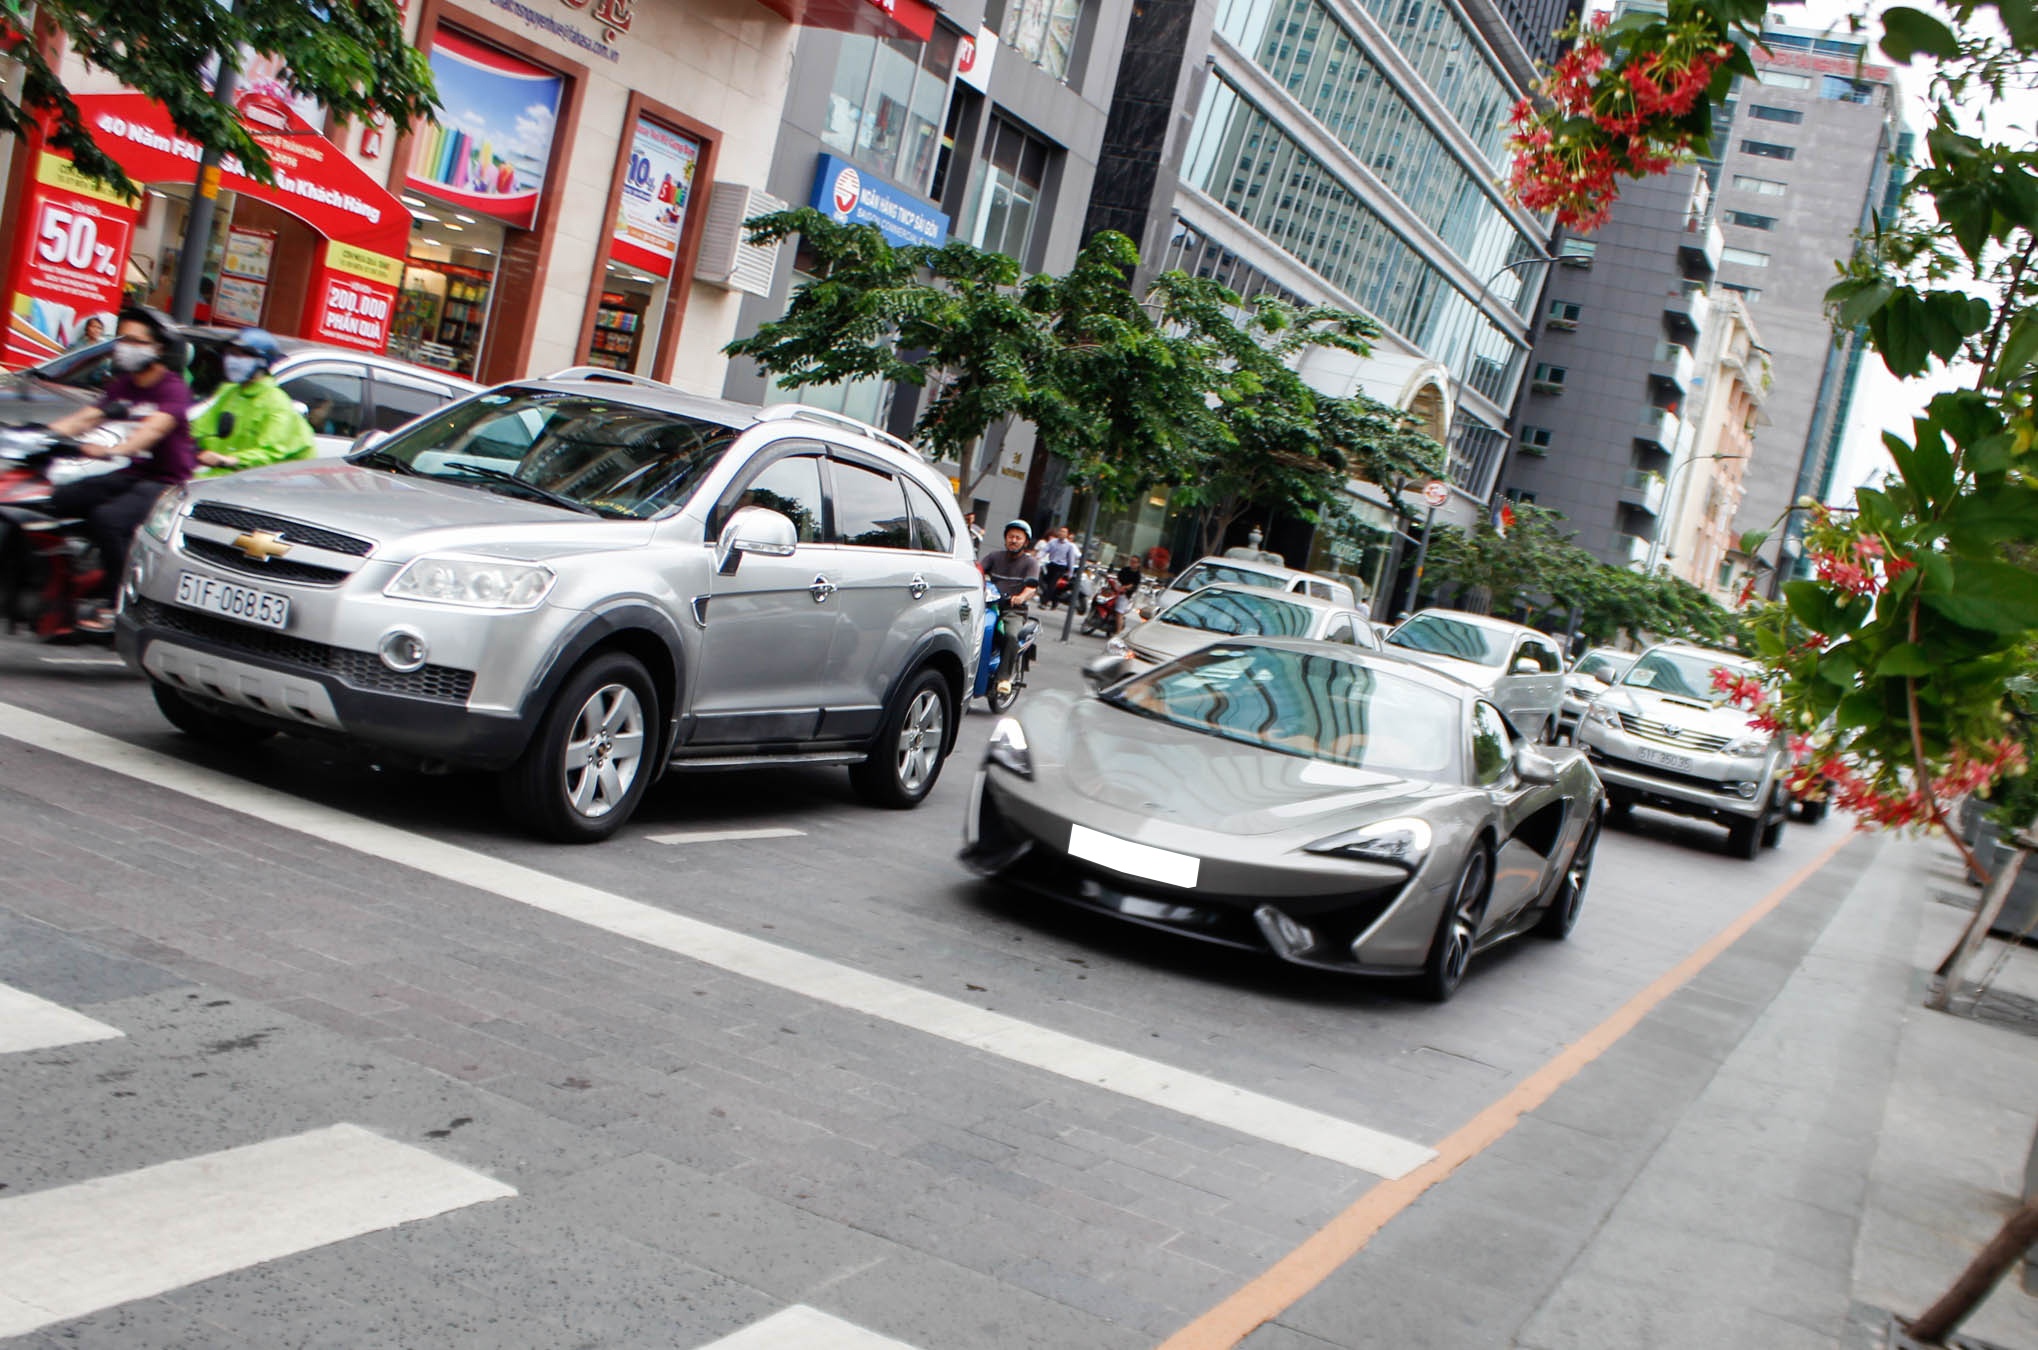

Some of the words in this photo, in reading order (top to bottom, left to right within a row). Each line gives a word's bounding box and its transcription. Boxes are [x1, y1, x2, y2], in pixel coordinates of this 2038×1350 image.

[97, 113, 126, 138] 40
[127, 122, 172, 154] Năm
[296, 177, 345, 212] Khách
[343, 195, 382, 225] Hàng
[860, 187, 880, 210] NGÂN
[878, 195, 898, 220] HÀNG
[37, 204, 117, 277] 50%
[327, 285, 388, 321] 200.000
[180, 575, 286, 625] 51F-068.53
